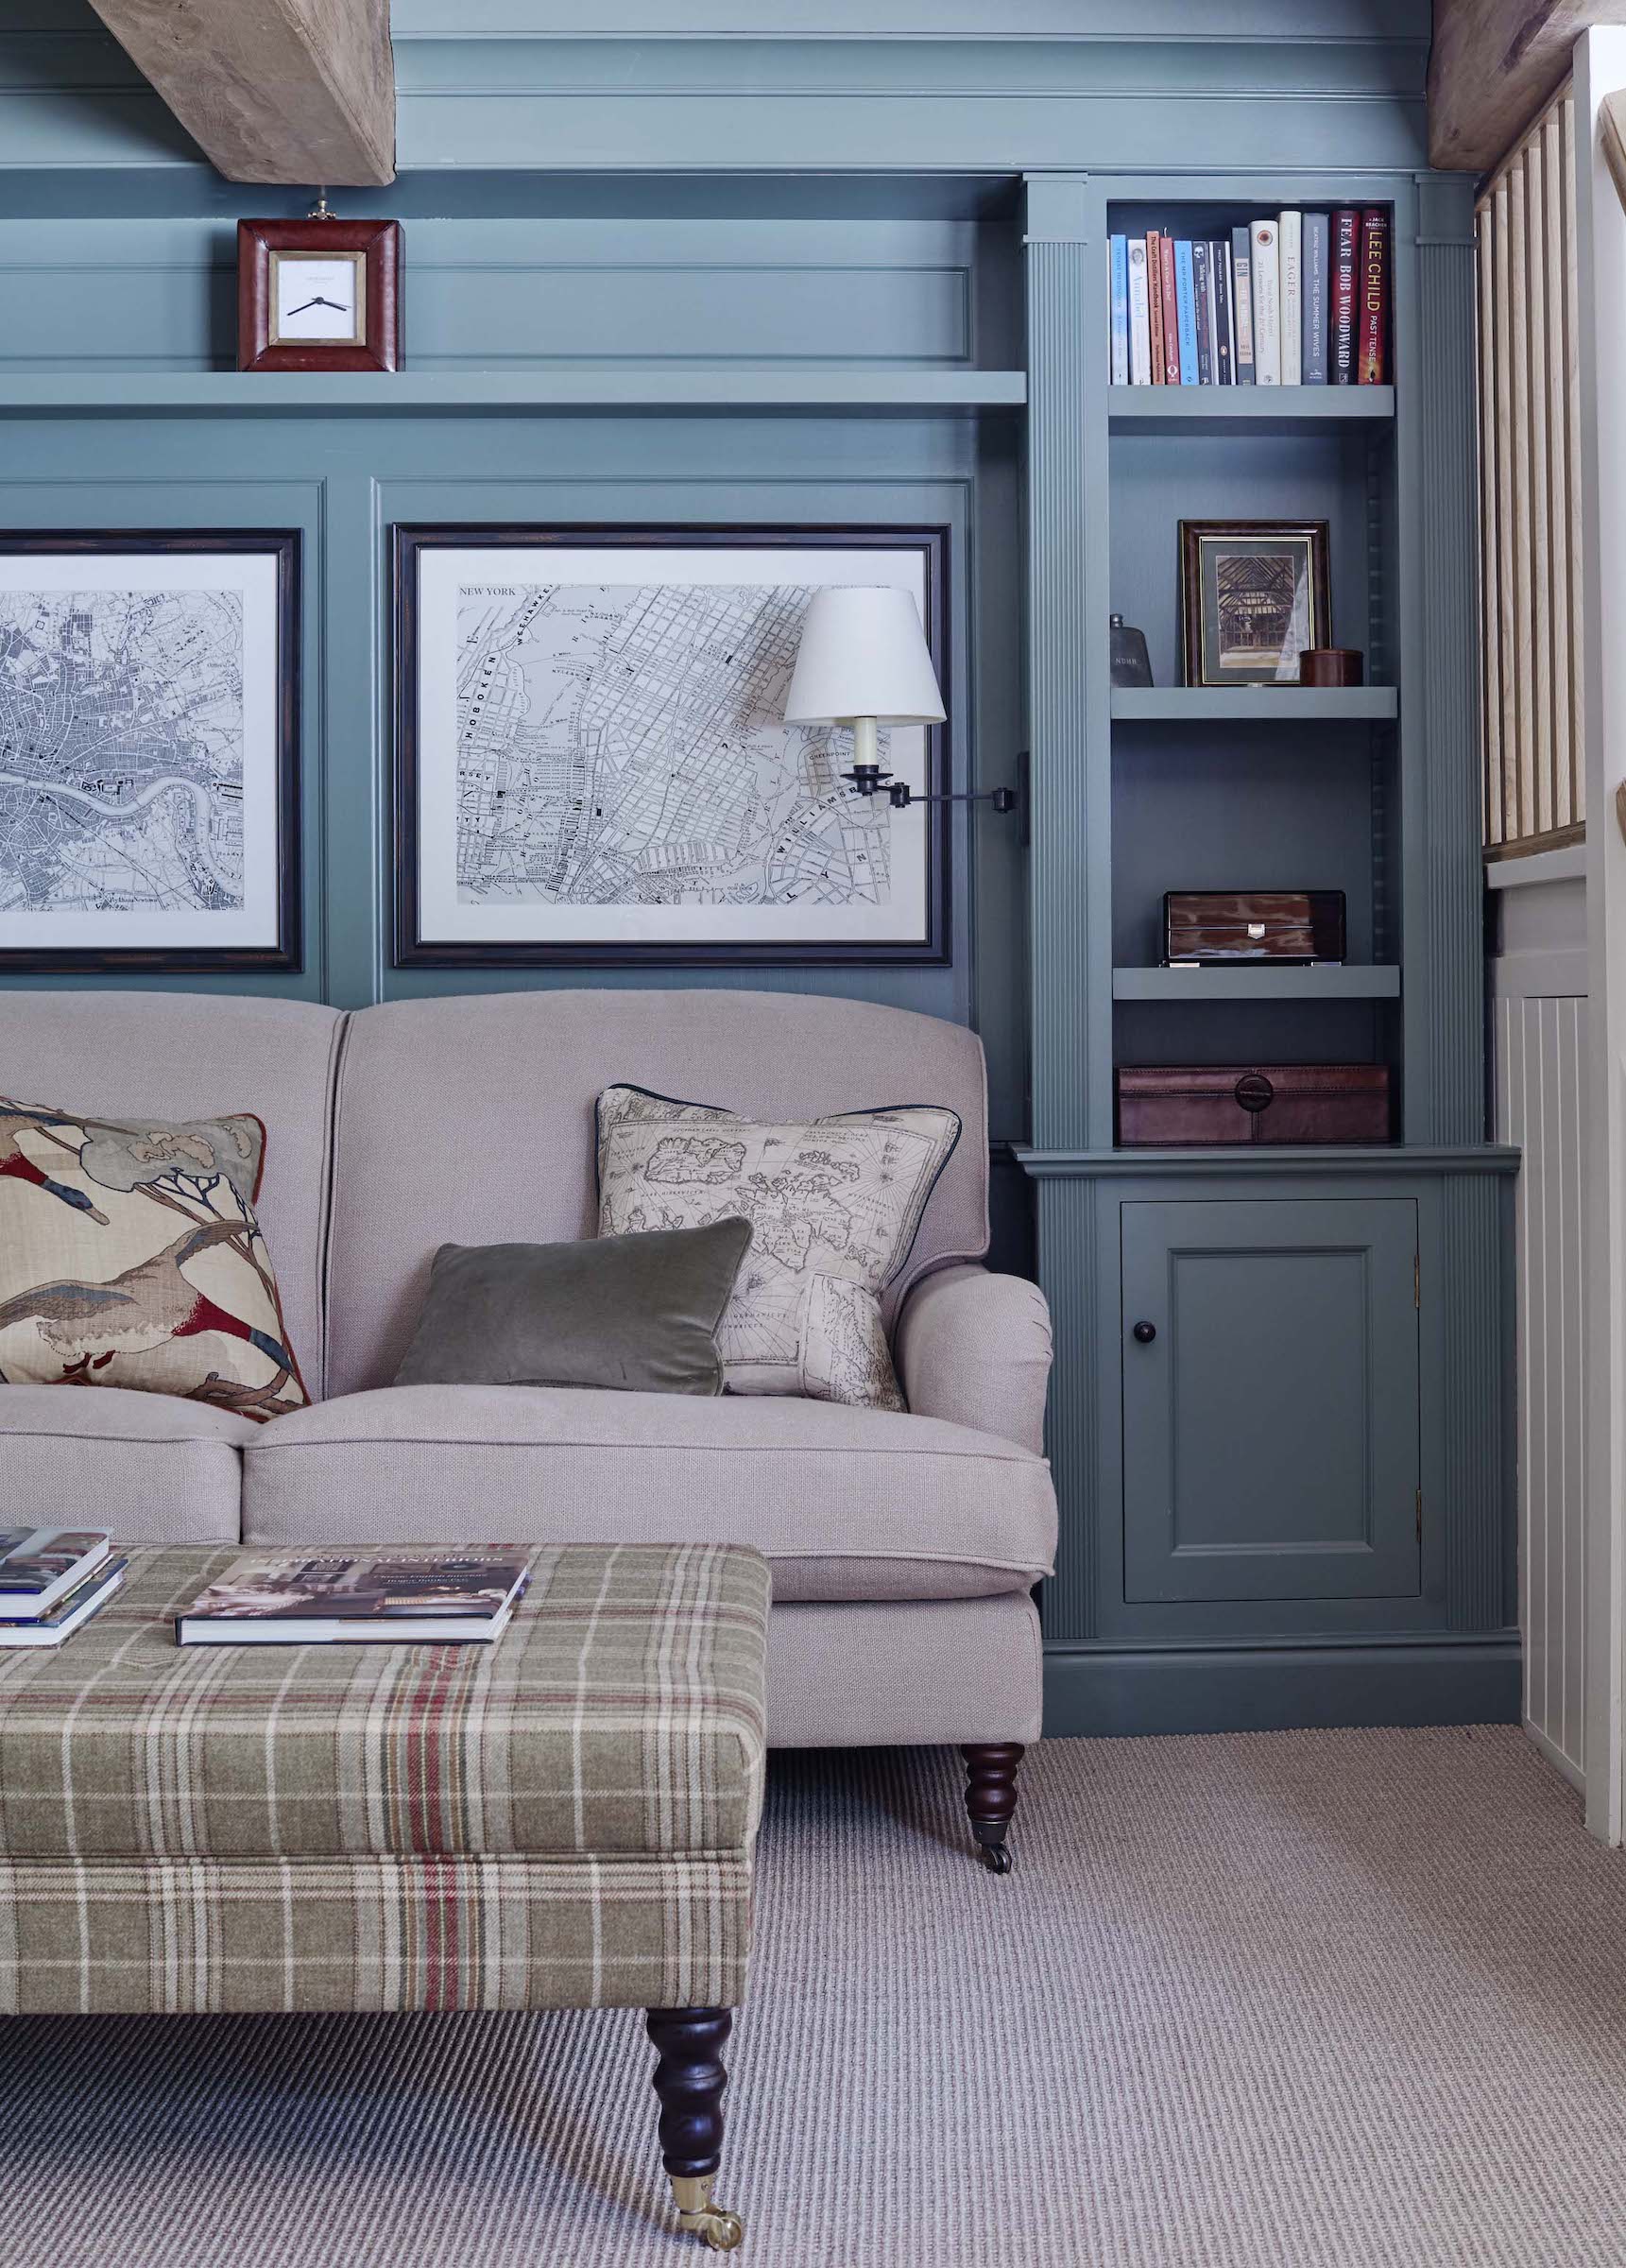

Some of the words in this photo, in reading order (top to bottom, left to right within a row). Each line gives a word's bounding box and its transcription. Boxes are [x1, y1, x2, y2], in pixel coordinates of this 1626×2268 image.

[1341, 218, 1353, 257] FEAR
[1368, 232, 1382, 260] LEE
[1237, 262, 1248, 278] GIN
[1287, 256, 1296, 298] EAGER
[1340, 265, 1352, 291] BOB
[1366, 263, 1381, 311] CHILD
[1338, 296, 1351, 368] WOODWARD
[1369, 316, 1378, 334] PAST
[1368, 335, 1377, 363] TENSE
[459, 587, 486, 596] NEW
[487, 587, 516, 596] YORK
[516, 584, 554, 646] WEEHAWKE
[466, 657, 496, 739] HOBOKEN
[810, 751, 850, 761] GREENPOINT
